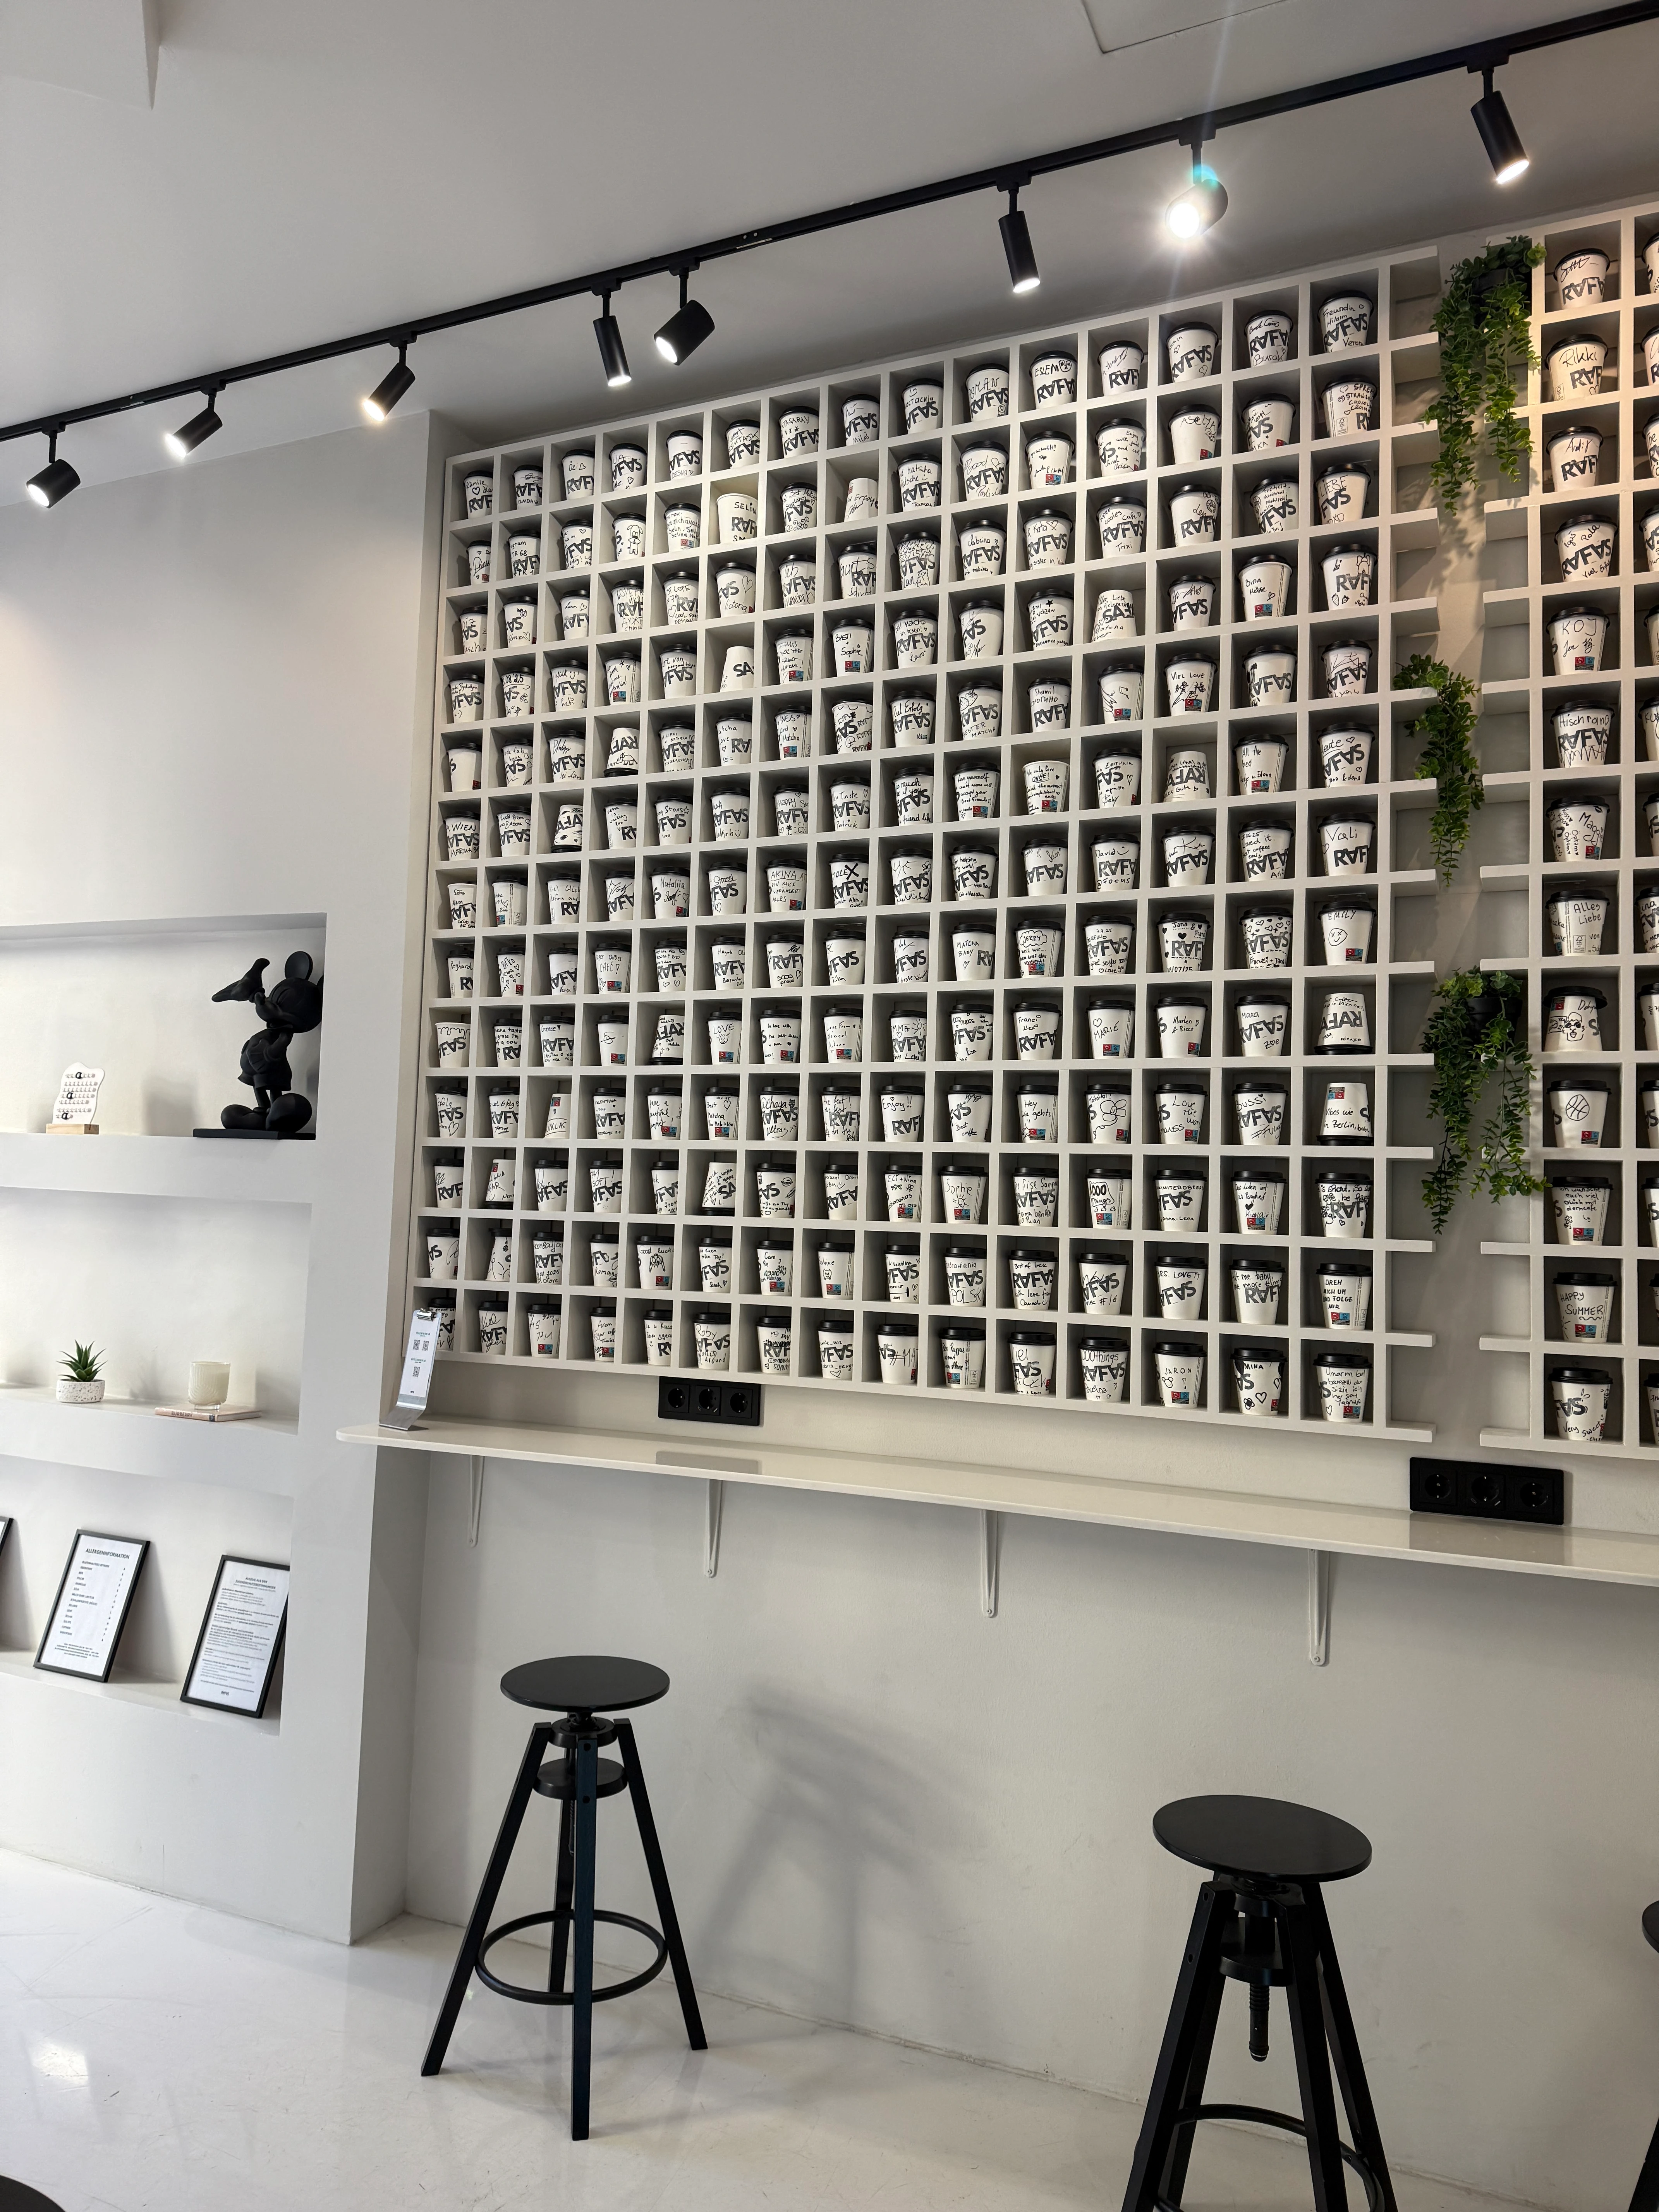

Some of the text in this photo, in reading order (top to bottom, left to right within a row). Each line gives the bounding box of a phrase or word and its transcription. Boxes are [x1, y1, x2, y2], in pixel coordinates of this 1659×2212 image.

[1322, 304, 1355, 318] Freundin
[1559, 347, 1597, 366] Rikki
[453, 822, 476, 831] WIEN
[1574, 902, 1600, 914] Alles
[1579, 914, 1601, 925] Liebe
[713, 1024, 734, 1034] LOVE
[1560, 1292, 1584, 1302] HAPPY
[1566, 1304, 1604, 1316] SUMMER
